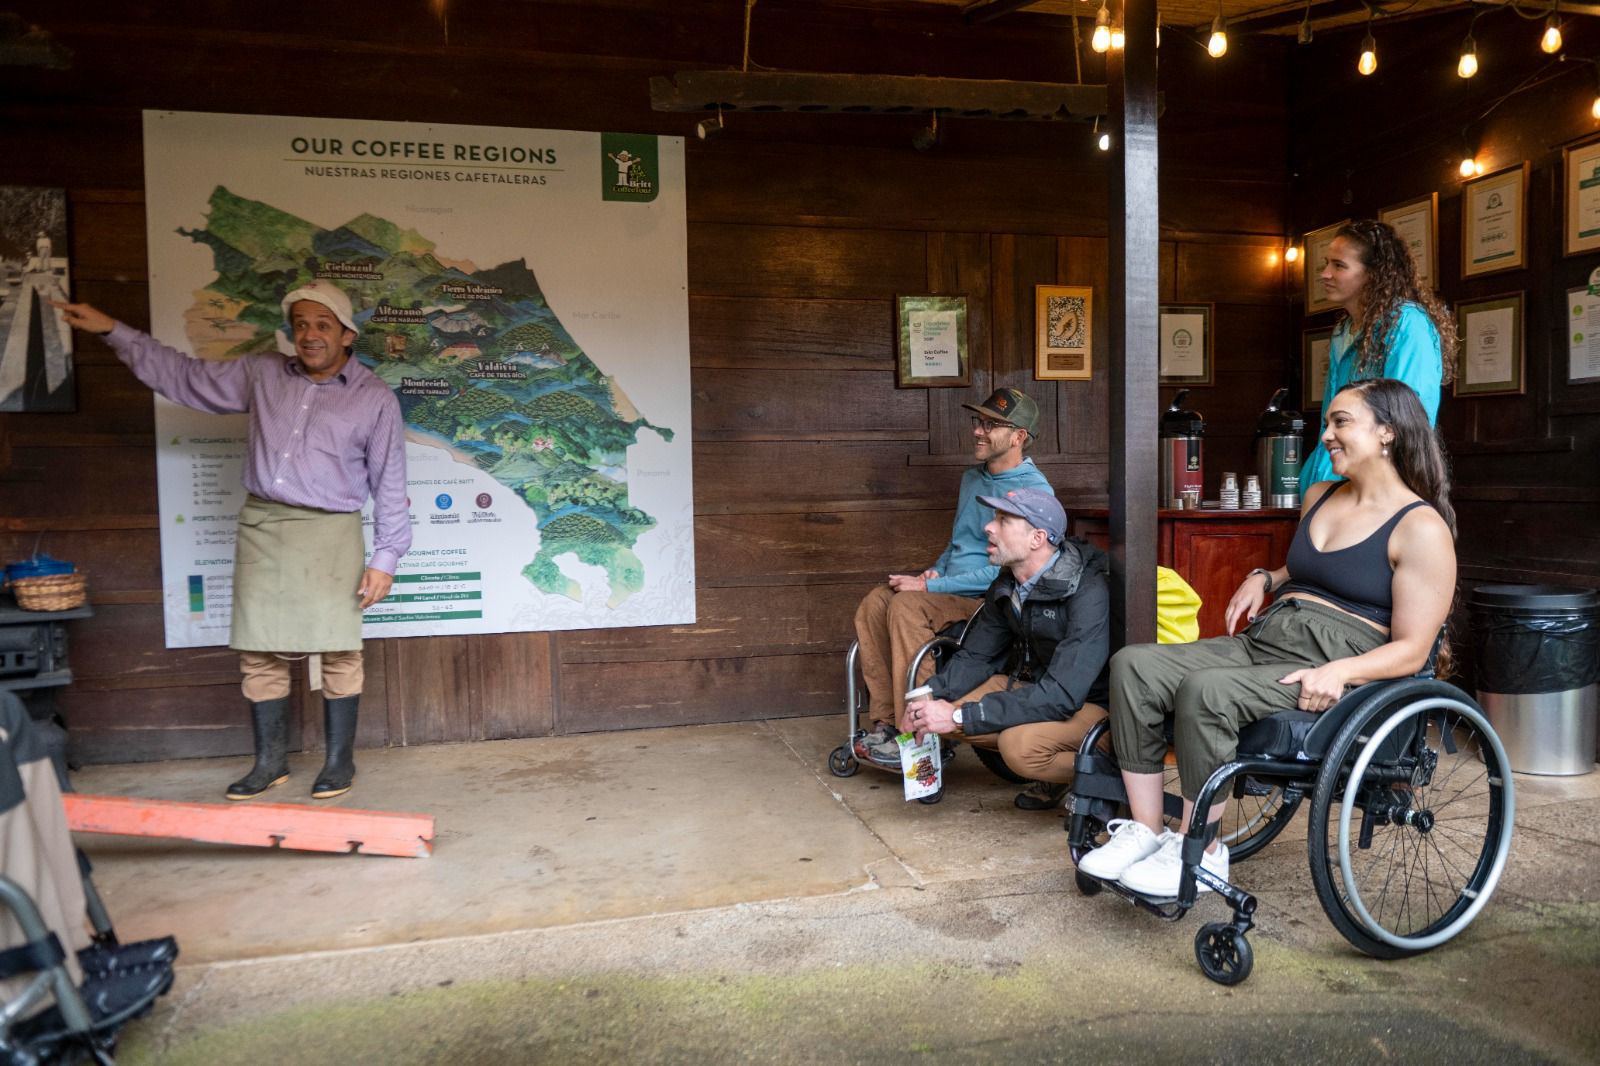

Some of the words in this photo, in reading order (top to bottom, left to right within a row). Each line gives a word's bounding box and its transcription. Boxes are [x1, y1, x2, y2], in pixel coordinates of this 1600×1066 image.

[291, 137, 343, 155] OUR
[352, 140, 445, 159] COFFEE
[454, 145, 557, 164] REGIONS
[305, 166, 377, 178] NUESTRAS
[381, 169, 450, 181] REGIONES
[455, 172, 547, 185] CAFETALERAS
[378, 305, 422, 315] Altozano
[478, 361, 517, 371] Valdivia
[402, 379, 449, 387] Montecielo
[406, 549, 440, 557] GOURMET
[440, 548, 468, 556] COFFEE
